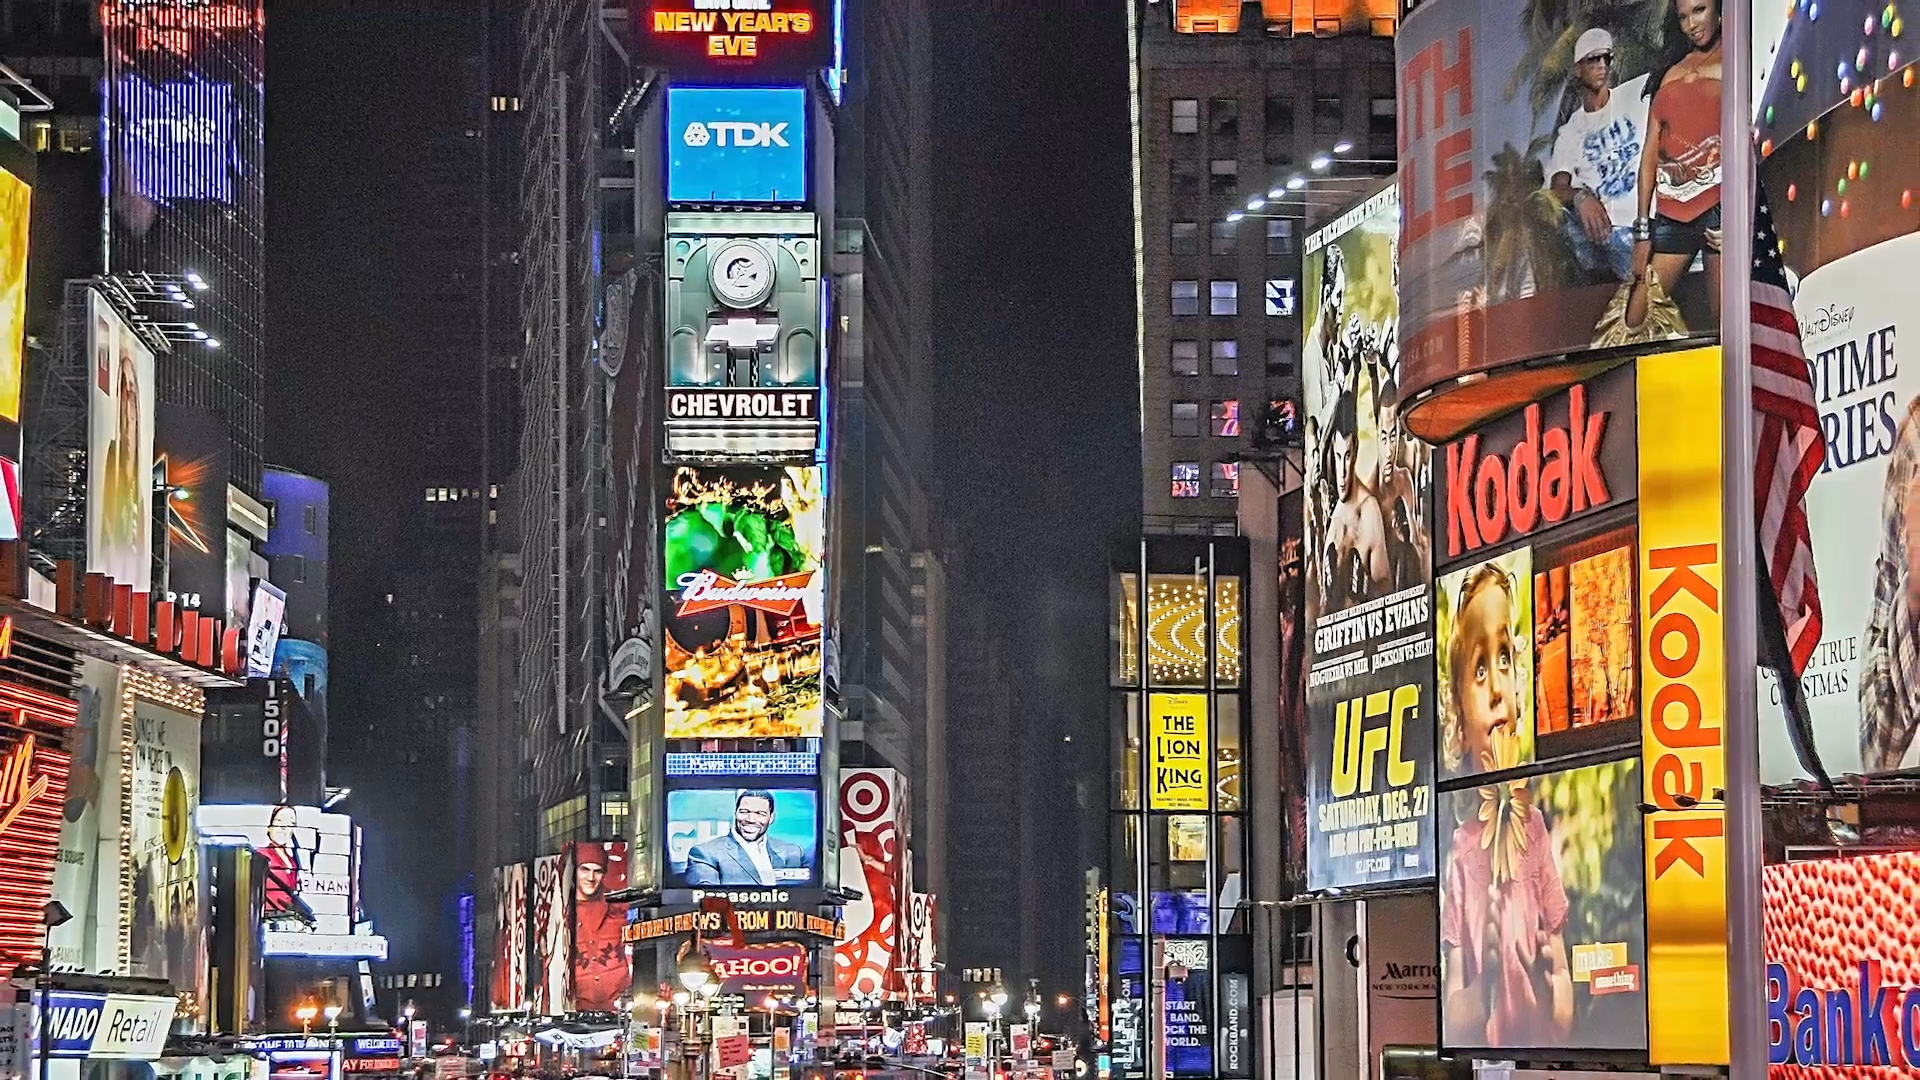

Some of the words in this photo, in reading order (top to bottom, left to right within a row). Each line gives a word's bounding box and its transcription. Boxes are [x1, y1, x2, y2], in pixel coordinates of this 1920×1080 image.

[654, 12, 717, 32] NEW
[722, 12, 812, 33] YEAR'S
[708, 35, 757, 57] EVE
[707, 121, 790, 147] TDK
[671, 394, 812, 417] CHEVROLET
[1821, 391, 1896, 474] RIES
[1446, 384, 1611, 557] Kodak
[181, 592, 202, 608] 14
[1315, 615, 1367, 654] GRIFFIN
[1366, 609, 1384, 638] VS
[1385, 596, 1429, 633] EVANS
[1371, 647, 1404, 674] JACKSON
[1820, 637, 1857, 666] TRUE
[1770, 669, 1849, 706] CSTMAS
[263, 680, 280, 757] 1500
[1163, 716, 1194, 730] THE
[1649, 543, 1724, 881] Kodak
[1157, 737, 1200, 762] LION
[1331, 684, 1420, 798] UFC
[688, 757, 726, 772] News
[1157, 767, 1202, 793] KING
[1318, 795, 1382, 833] SATURDAY,
[1383, 789, 1412, 822] DEC.
[1413, 785, 1430, 817] 27
[1575, 942, 1614, 972] make
[1595, 971, 1634, 989] something
[1166, 1001, 1196, 1011] START
[1170, 1013, 1202, 1022] BAND.
[1767, 960, 1892, 1068] Bank
[107, 1008, 161, 1043] Retail
[1165, 1025, 1185, 1035] OCK
[1188, 1025, 1207, 1035] THE
[1230, 979, 1238, 1070] ROCKBAND.COM
